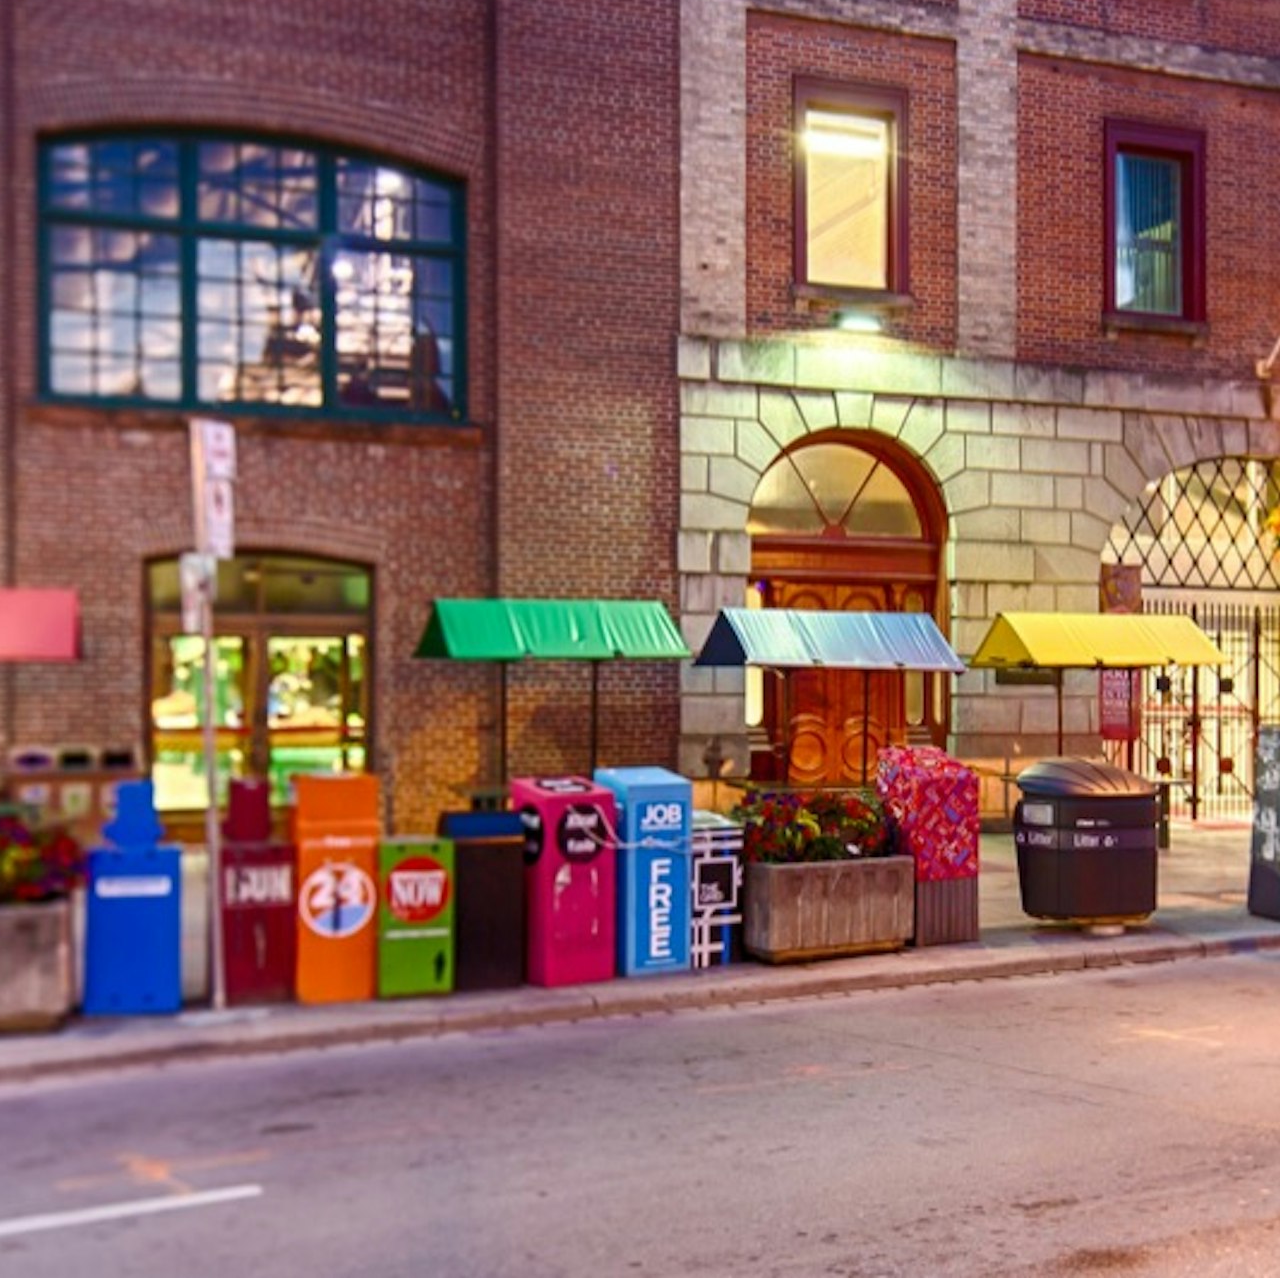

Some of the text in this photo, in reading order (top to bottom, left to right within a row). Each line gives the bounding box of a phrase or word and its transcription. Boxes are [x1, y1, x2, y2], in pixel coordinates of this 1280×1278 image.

[642, 803, 683, 823] JOB
[1073, 833, 1100, 847] Litter
[389, 869, 447, 908] NOW
[649, 858, 673, 958] FREE
